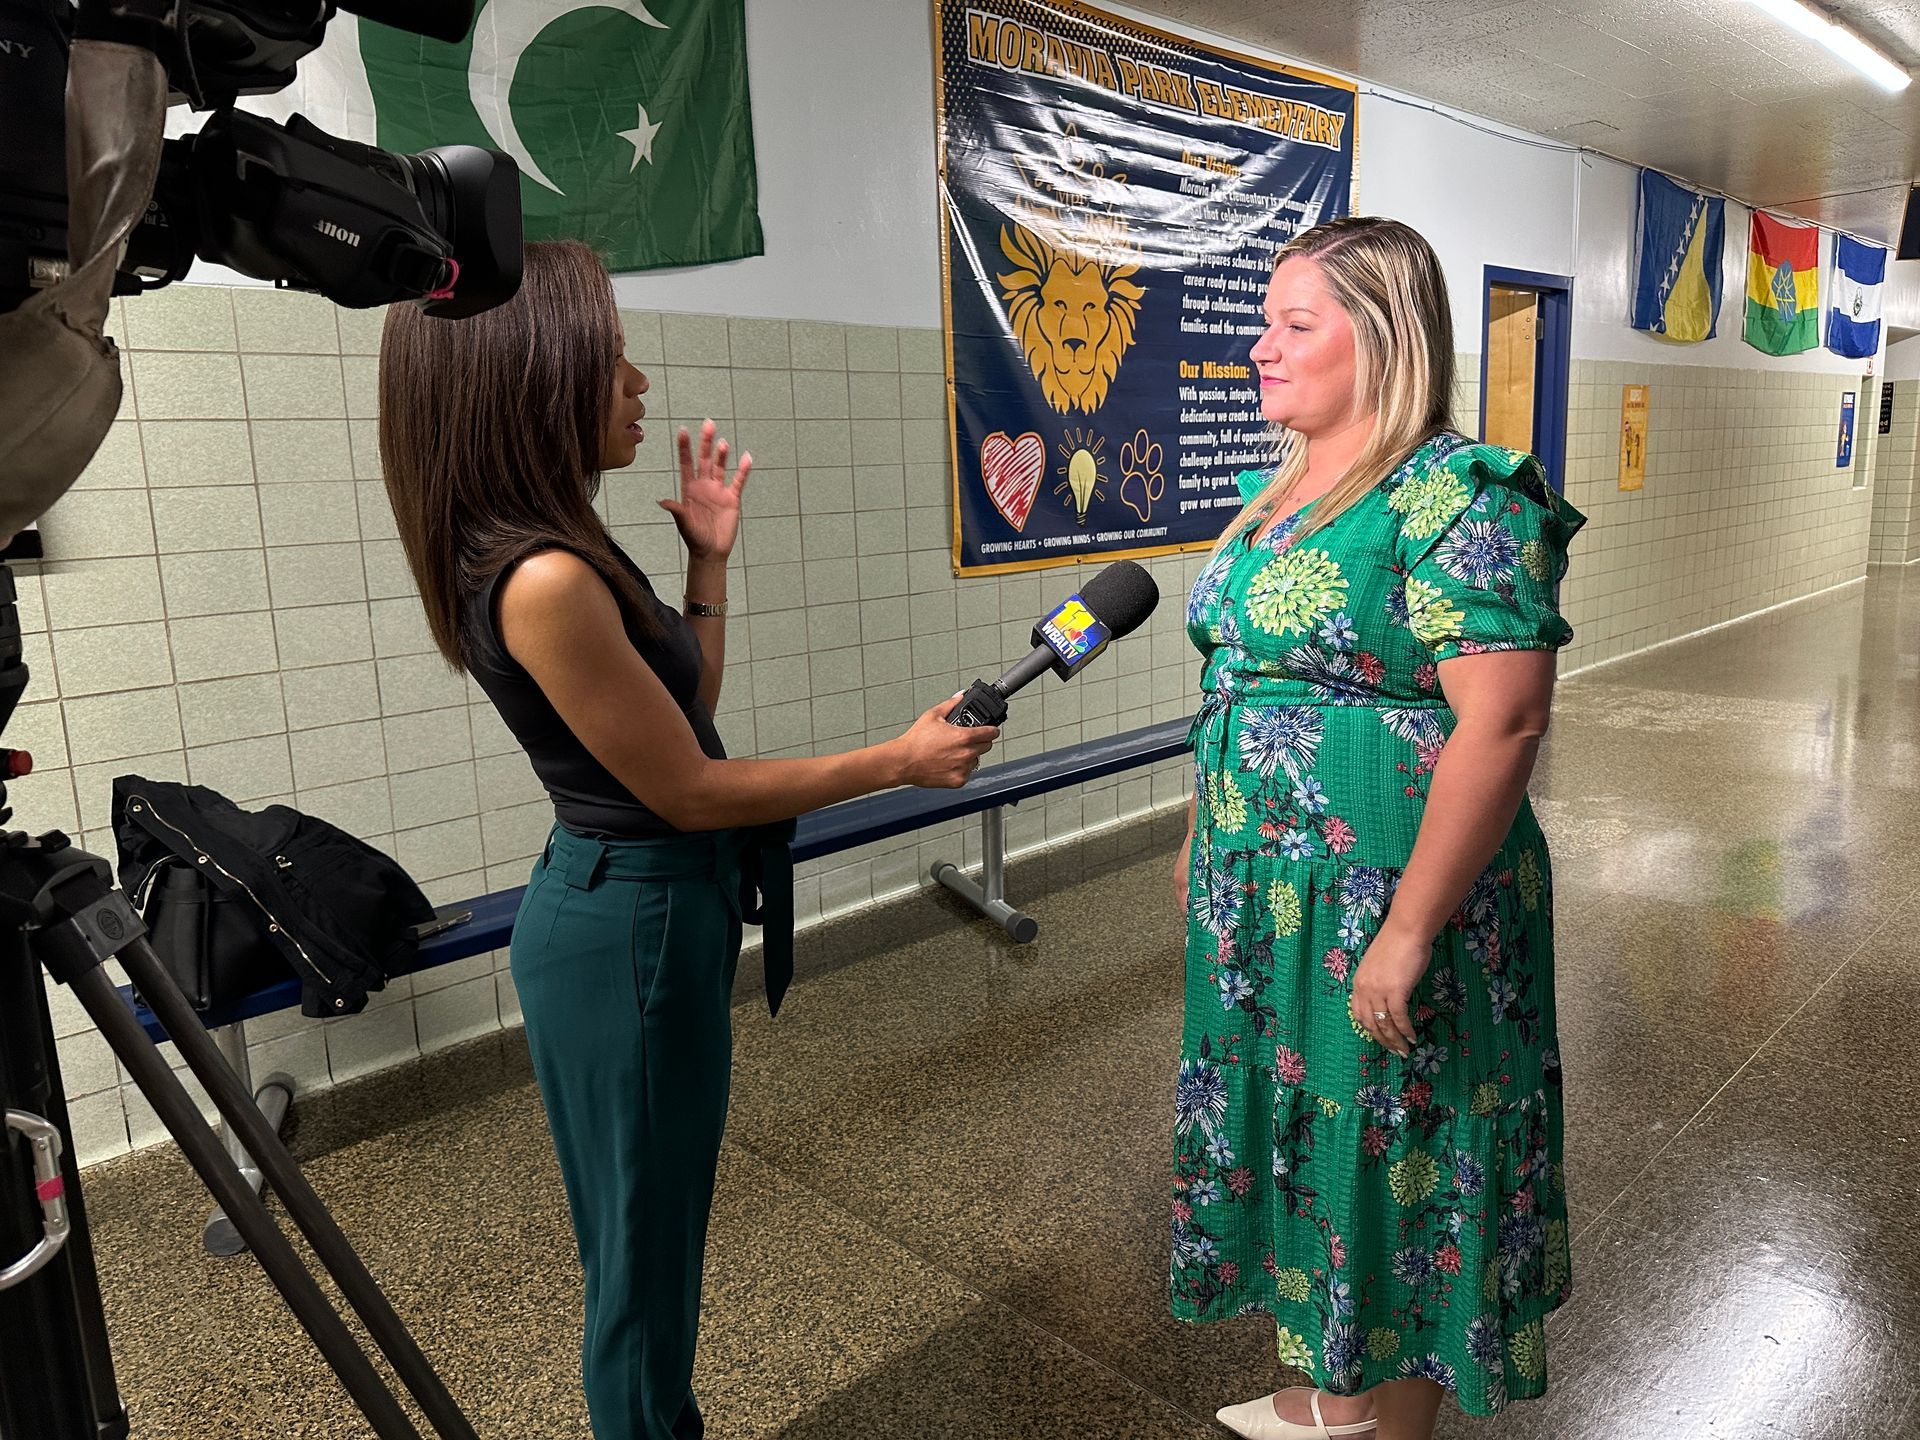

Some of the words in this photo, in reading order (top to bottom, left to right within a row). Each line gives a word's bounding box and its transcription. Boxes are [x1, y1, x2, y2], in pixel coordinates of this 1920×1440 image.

[966, 8, 1119, 96] MORAVIA
[1115, 55, 1198, 115] PARK
[1194, 76, 1346, 151] ELEMENTARY
[1179, 177, 1209, 197] Moravia
[1203, 205, 1219, 220] that
[313, 220, 360, 247] anon
[1200, 253, 1231, 269] prepares
[1232, 253, 1257, 270] scholars
[1257, 258, 1264, 271] to
[1264, 257, 1273, 272] be
[1183, 275, 1206, 287] career
[1207, 273, 1227, 293] ready
[1227, 275, 1241, 291] and
[1241, 279, 1248, 292] to
[1248, 277, 1257, 293] be
[1182, 293, 1210, 314] through
[1211, 296, 1255, 315] collaborations
[1180, 316, 1208, 334] families
[1209, 319, 1223, 335] and
[1223, 320, 1235, 335] the
[1179, 360, 1199, 379] Our
[1202, 361, 1250, 379] Mission:
[1179, 386, 1197, 401] With
[1199, 387, 1228, 404] passion,
[1229, 386, 1258, 404] integrity,
[1180, 408, 1215, 423] dedication
[1217, 412, 1228, 422] we
[1228, 410, 1248, 422] create
[1250, 411, 1255, 421] a
[1179, 431, 1219, 447] community,
[1220, 429, 1232, 444] full
[1233, 428, 1241, 443] of
[1179, 451, 1212, 469] challenge
[1213, 450, 1223, 465] all
[1224, 448, 1260, 465] individuals
[1179, 473, 1201, 491] family
[1202, 475, 1210, 487] to
[1211, 476, 1229, 490] grow
[1180, 500, 1198, 514] grow
[1199, 498, 1212, 509] our
[981, 541, 1012, 554] GROWING
[1013, 539, 1037, 551] HEARTS
[1043, 536, 1072, 547] GROWING
[1072, 534, 1091, 545] MINDS
[1096, 531, 1123, 542] GROWING
[1123, 529, 1136, 539] OUR
[1136, 526, 1168, 538] COMMUNITY
